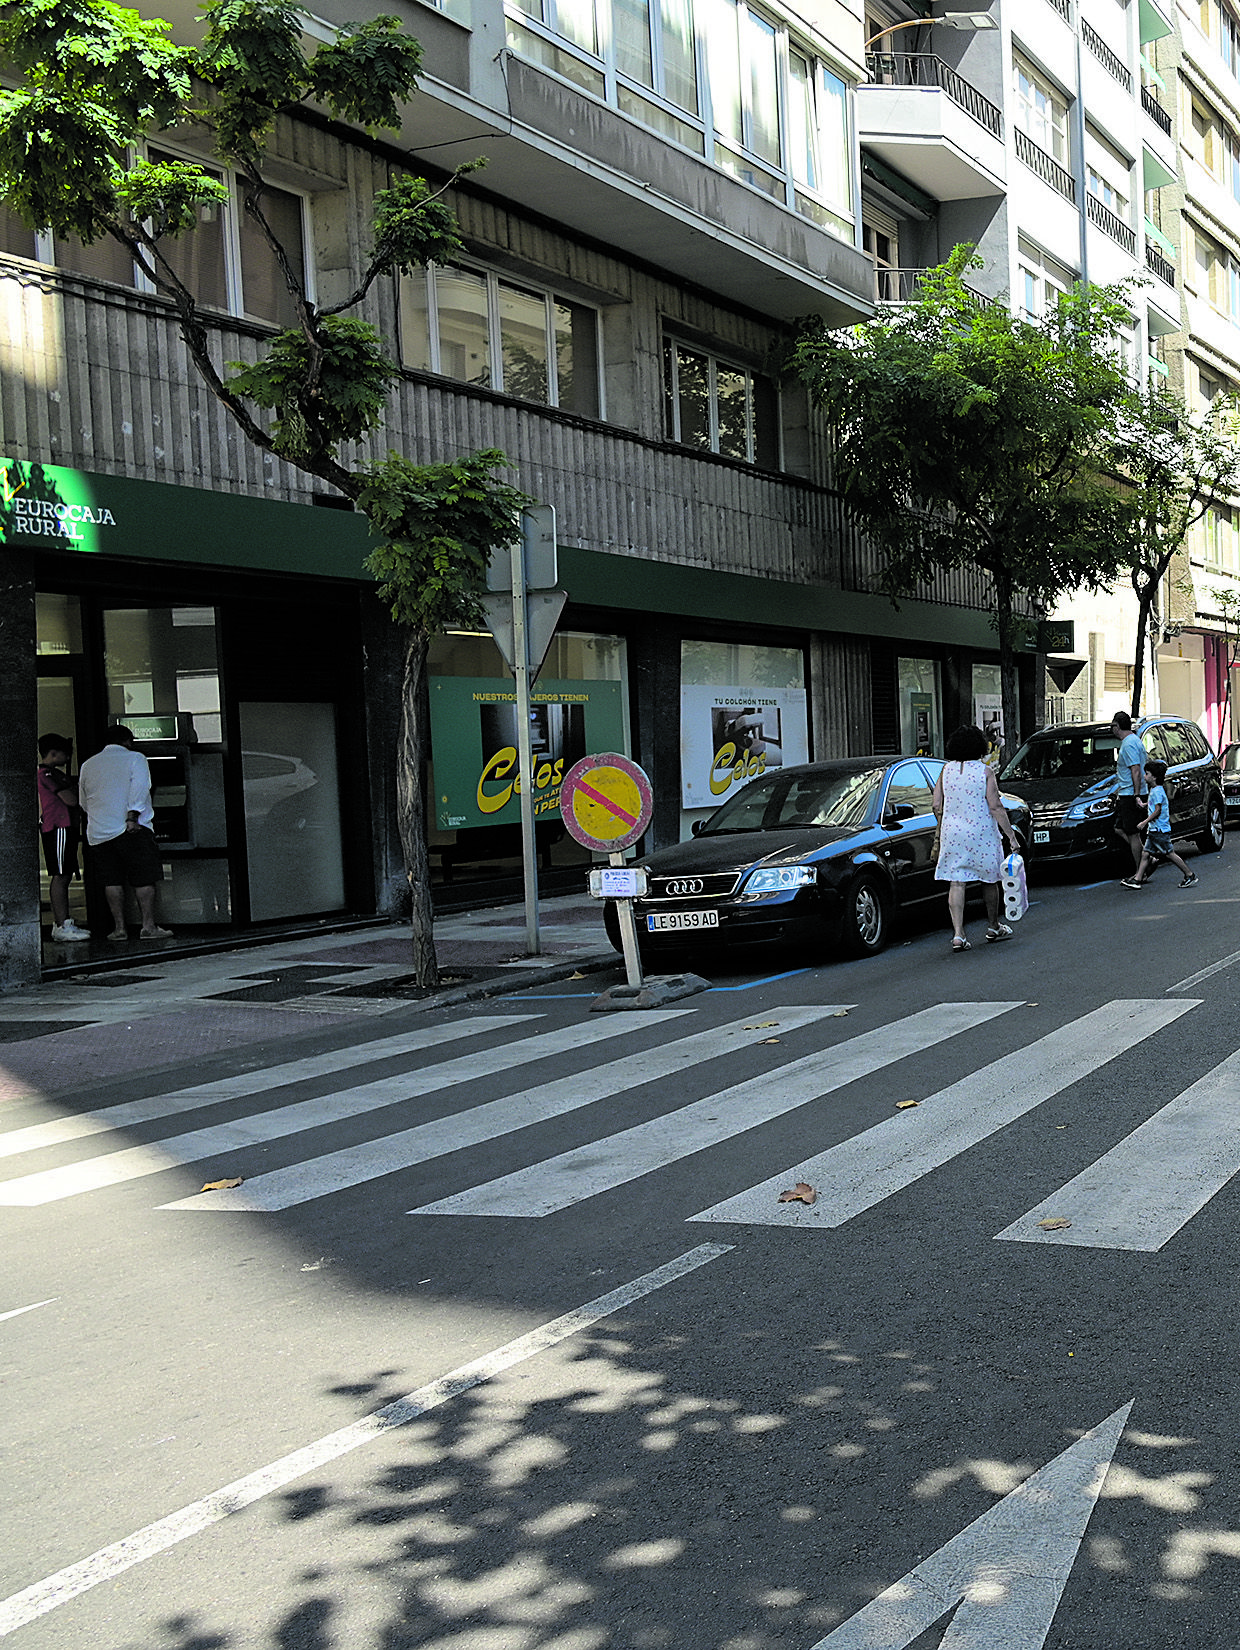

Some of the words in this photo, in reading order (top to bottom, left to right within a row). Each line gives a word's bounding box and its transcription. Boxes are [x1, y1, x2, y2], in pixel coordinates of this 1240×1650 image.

[15, 498, 116, 525] EUROCAJA
[16, 516, 85, 540] RURAL
[473, 693, 517, 701] NUESTROS
[725, 697, 757, 705] COLCHÓN
[709, 742, 767, 795] Celos
[1034, 832, 1047, 842] HP
[654, 916, 667, 929] LE
[669, 914, 699, 928] 9159
[702, 912, 717, 925] AD
